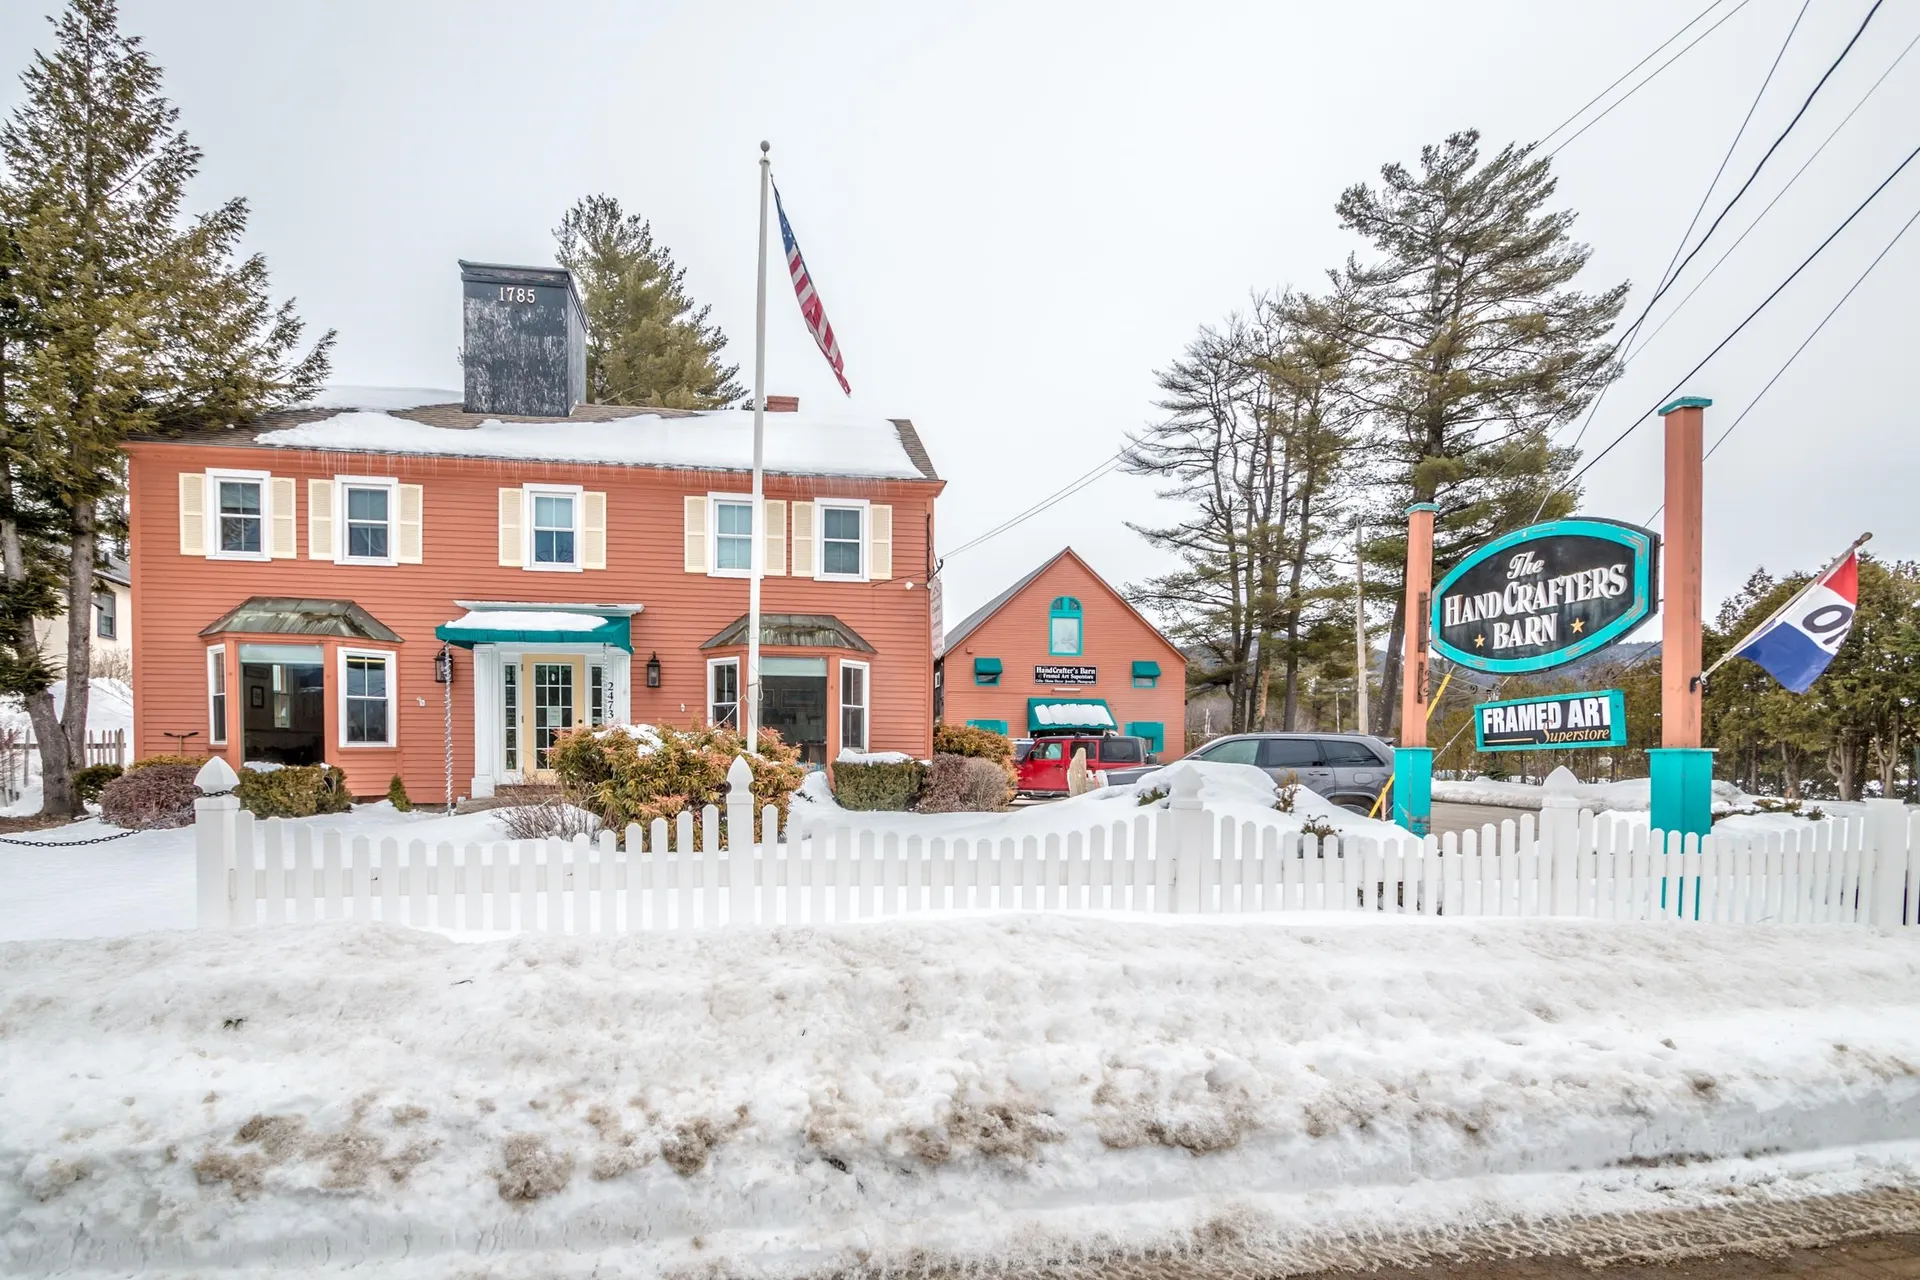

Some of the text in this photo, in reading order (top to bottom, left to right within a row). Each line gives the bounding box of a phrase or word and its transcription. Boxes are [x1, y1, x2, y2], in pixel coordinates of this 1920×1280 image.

[499, 287, 536, 304] 1785
[1507, 551, 1545, 580] The
[1492, 613, 1558, 650] BARN
[1483, 696, 1611, 734] FRAMED ART
[1536, 719, 1610, 745] Superstore
